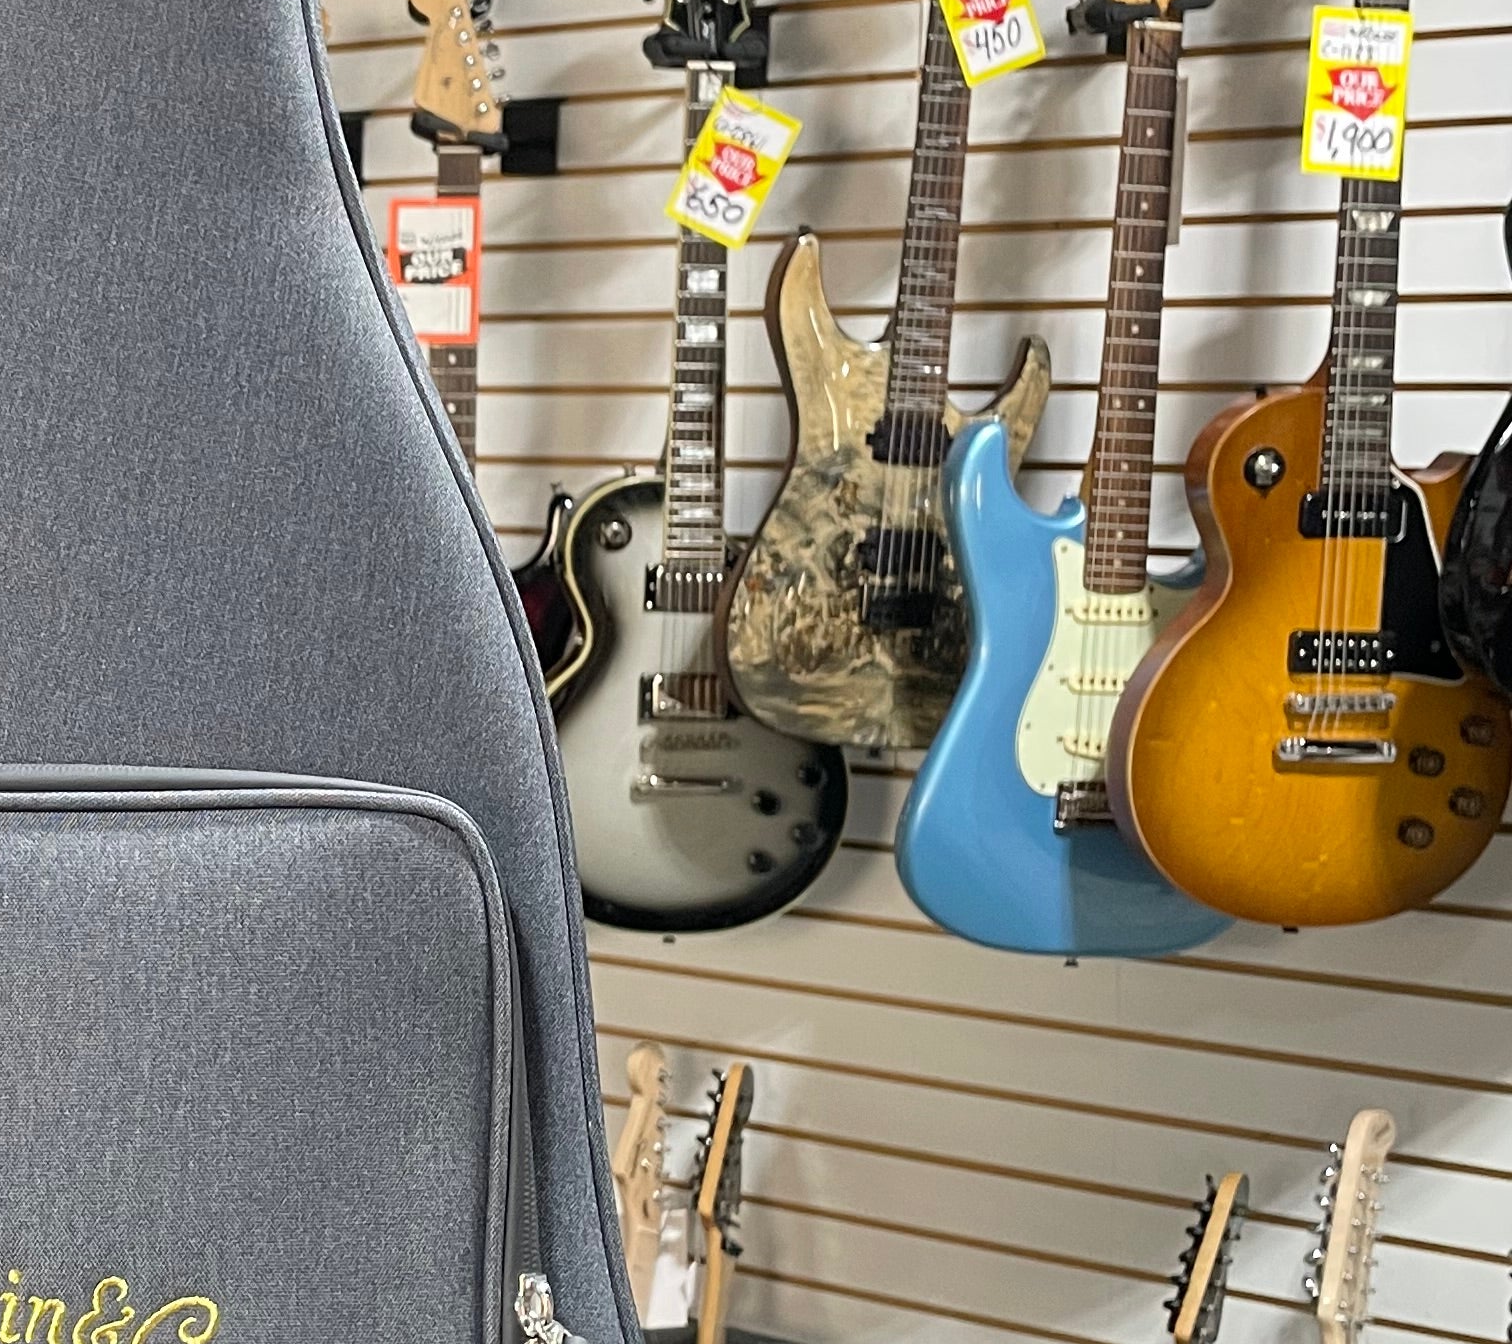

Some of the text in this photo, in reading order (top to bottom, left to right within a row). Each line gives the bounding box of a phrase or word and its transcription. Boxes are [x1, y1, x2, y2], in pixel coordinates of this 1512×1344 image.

[1339, 69, 1379, 88] OUR
[1333, 85, 1385, 108] PRICE
[721, 145, 755, 169] OUR
[711, 158, 755, 187] PRICE
[411, 248, 454, 267] OUR
[404, 260, 464, 282] PRICE
